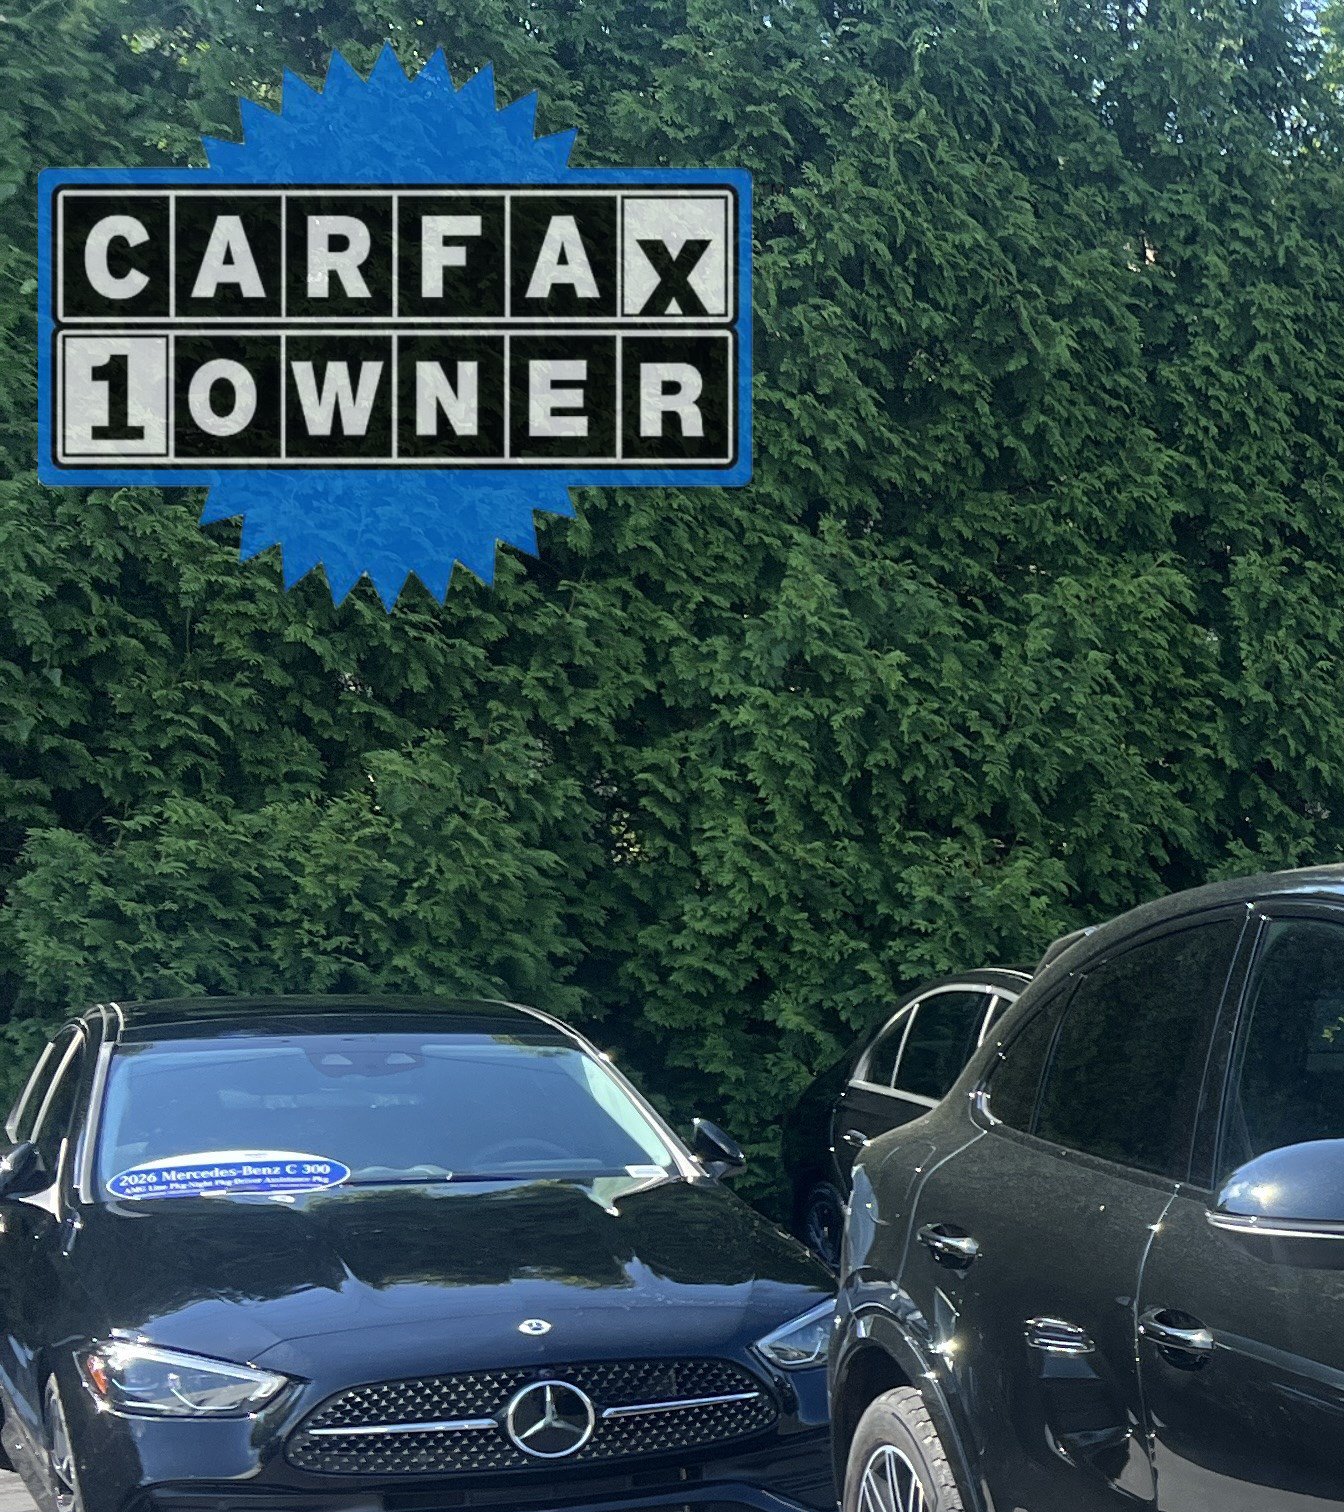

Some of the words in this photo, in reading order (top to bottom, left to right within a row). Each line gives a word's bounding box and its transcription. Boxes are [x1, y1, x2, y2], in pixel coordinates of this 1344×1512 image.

[119, 1172, 158, 1187] 2026
[161, 1164, 281, 1182] Mercedes-Benz
[285, 1164, 297, 1175] C
[301, 1163, 331, 1175] 300
